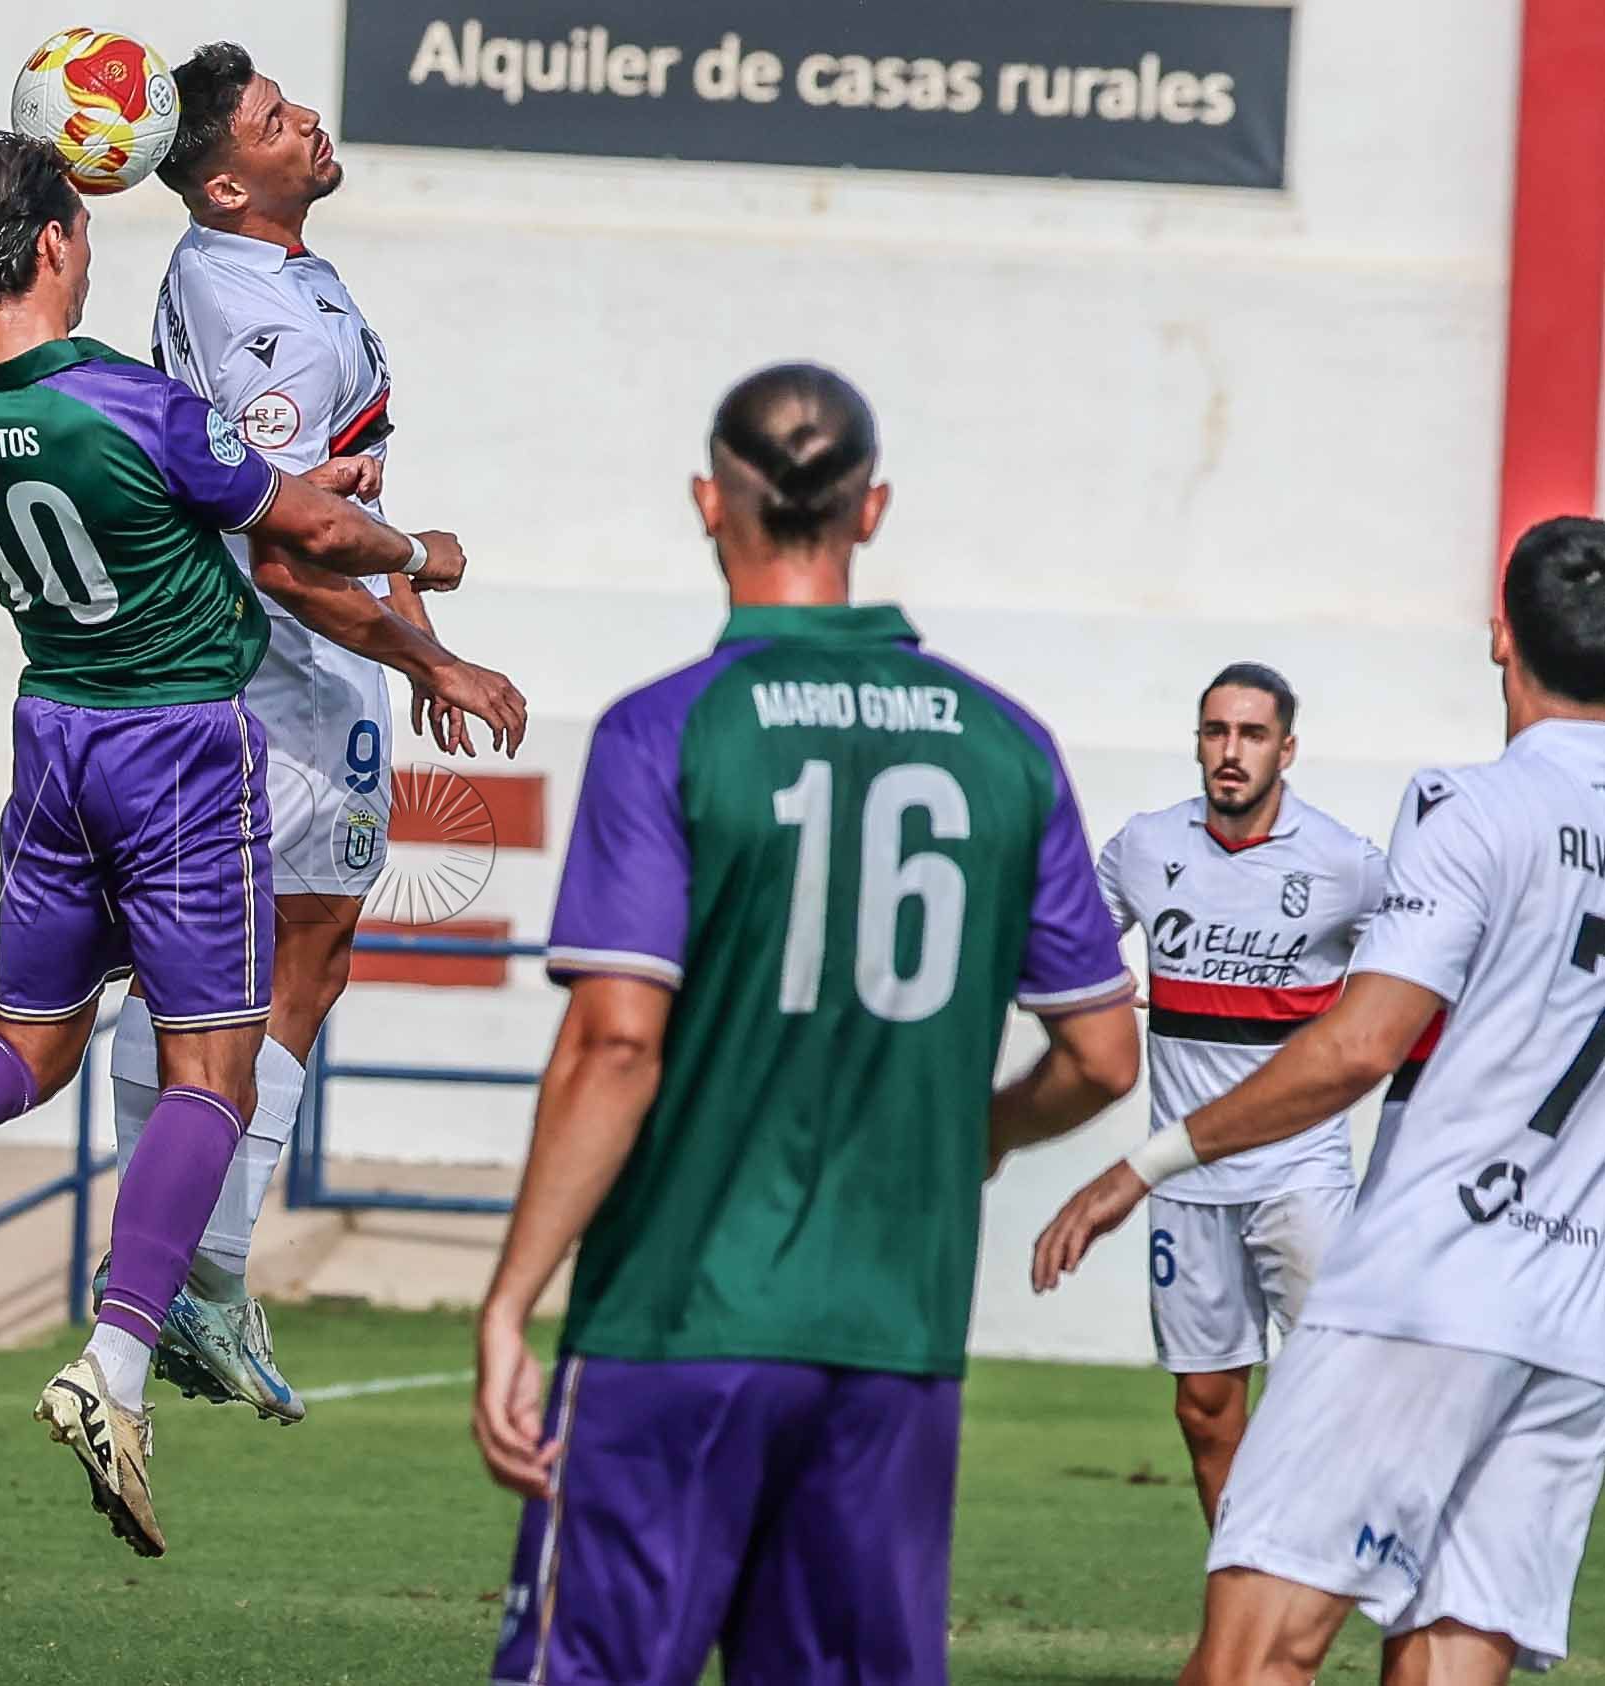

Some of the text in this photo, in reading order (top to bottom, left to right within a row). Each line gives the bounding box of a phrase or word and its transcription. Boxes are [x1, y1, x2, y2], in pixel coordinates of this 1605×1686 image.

[408, 20, 1237, 126] Alquiler de casas rurales
[751, 681, 856, 729] MARIO
[345, 719, 381, 794] 9
[772, 759, 971, 1022] 16
[1202, 958, 1295, 988] DEPORTE
[1528, 911, 1605, 1139] 7
[1150, 1228, 1177, 1288] 6
